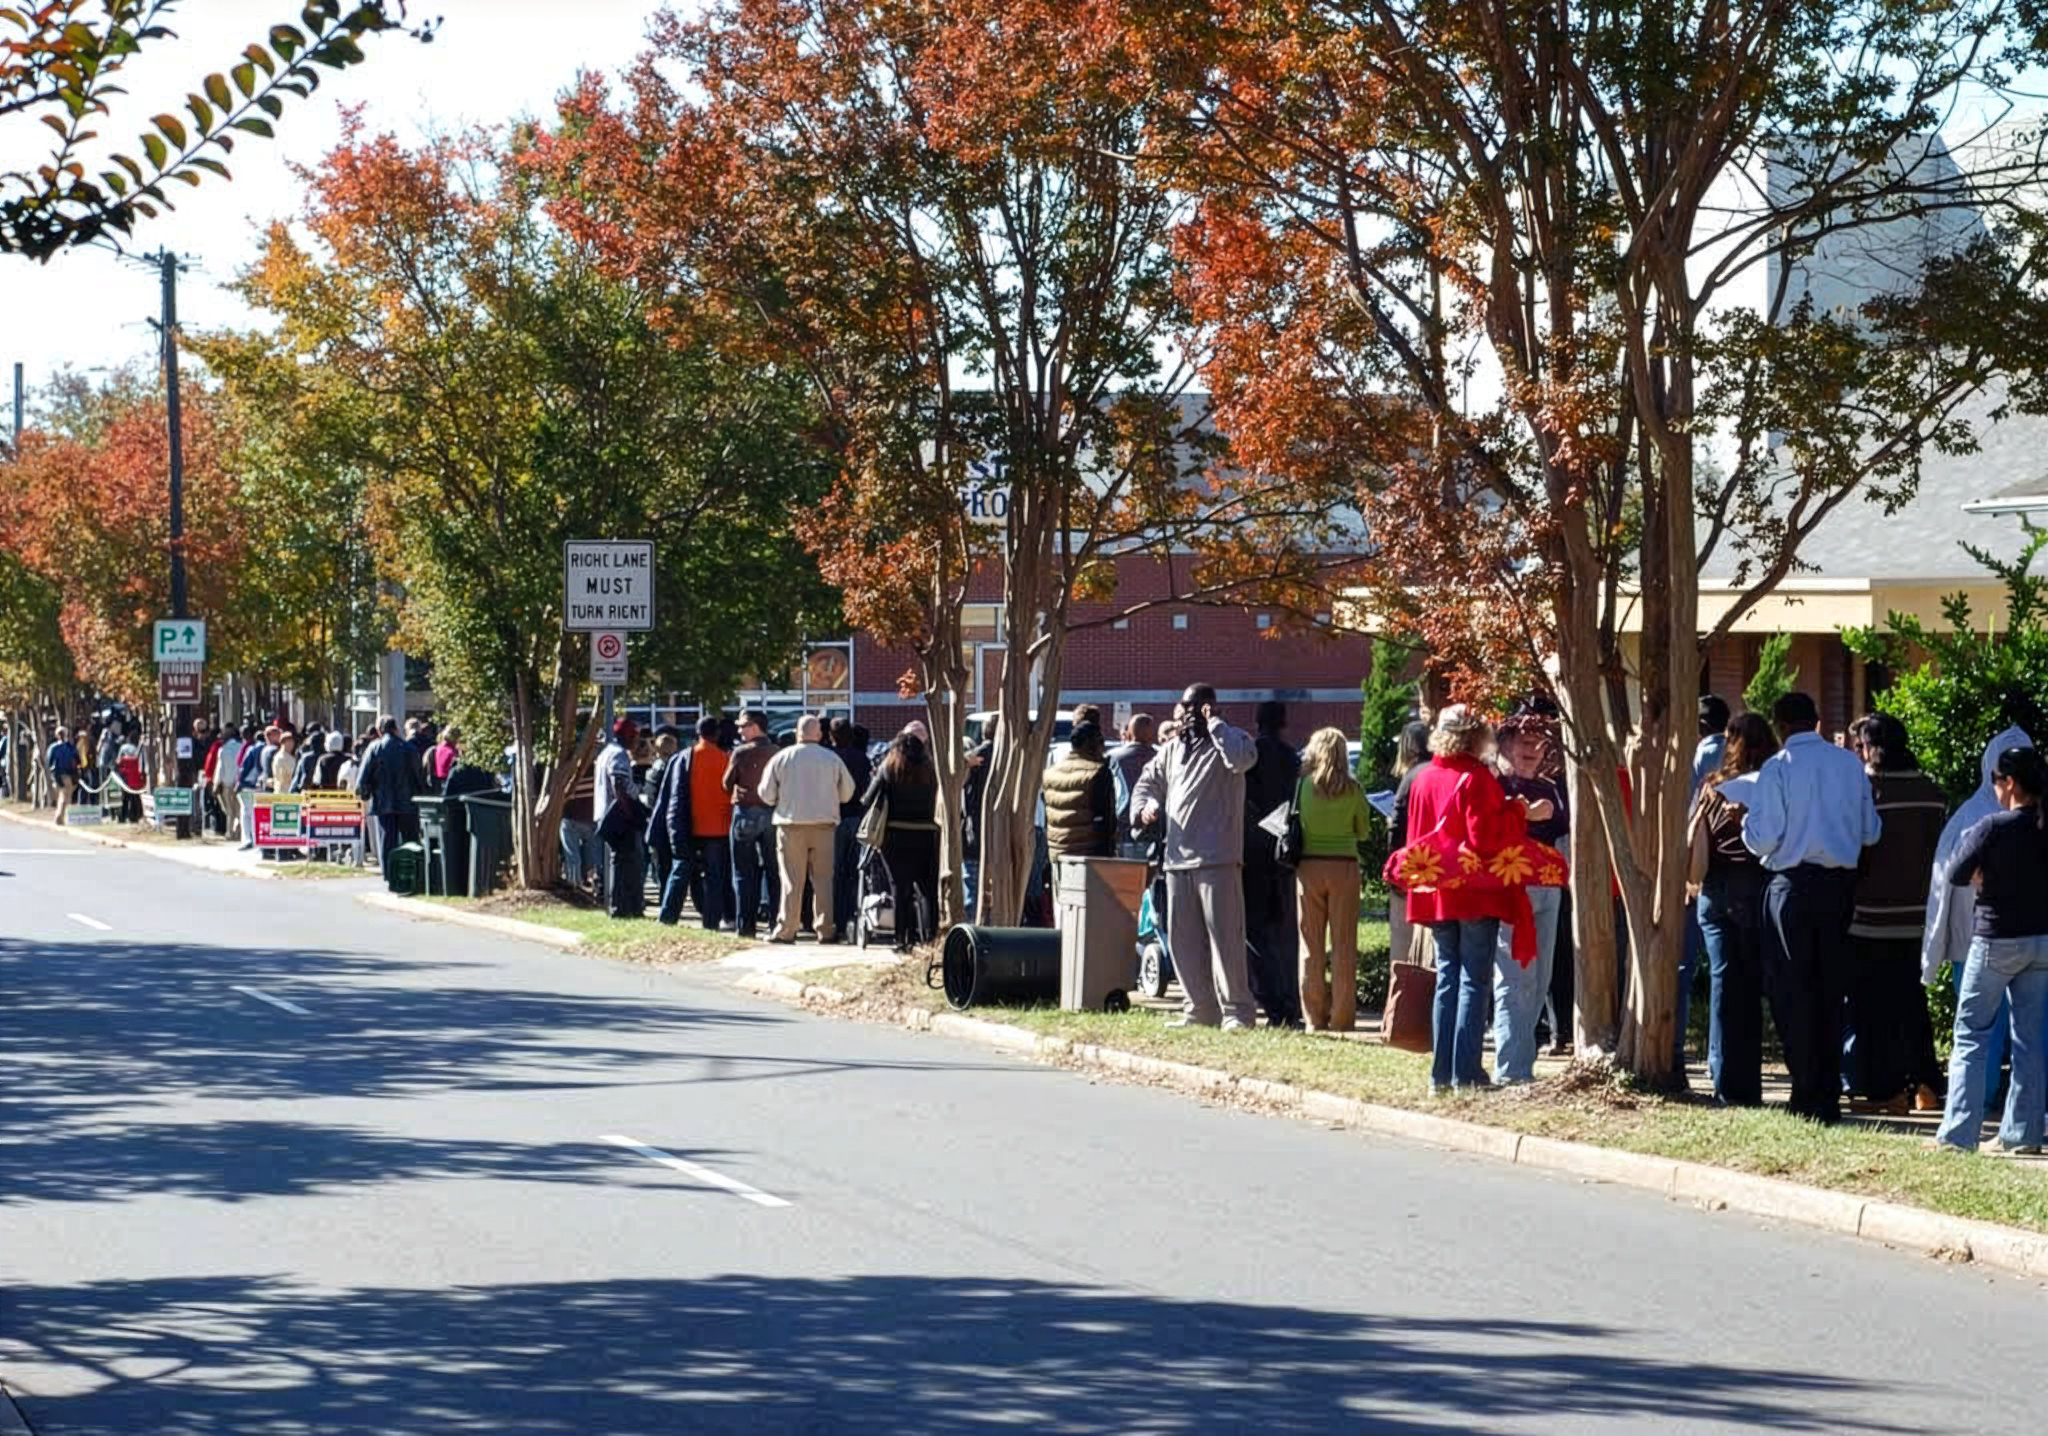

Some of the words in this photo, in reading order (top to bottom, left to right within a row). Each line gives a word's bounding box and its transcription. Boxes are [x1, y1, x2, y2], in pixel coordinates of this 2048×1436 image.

[613, 553, 648, 568] LANE
[586, 577, 633, 594] MUST
[571, 604, 604, 619] TURN
[160, 628, 177, 654] P
